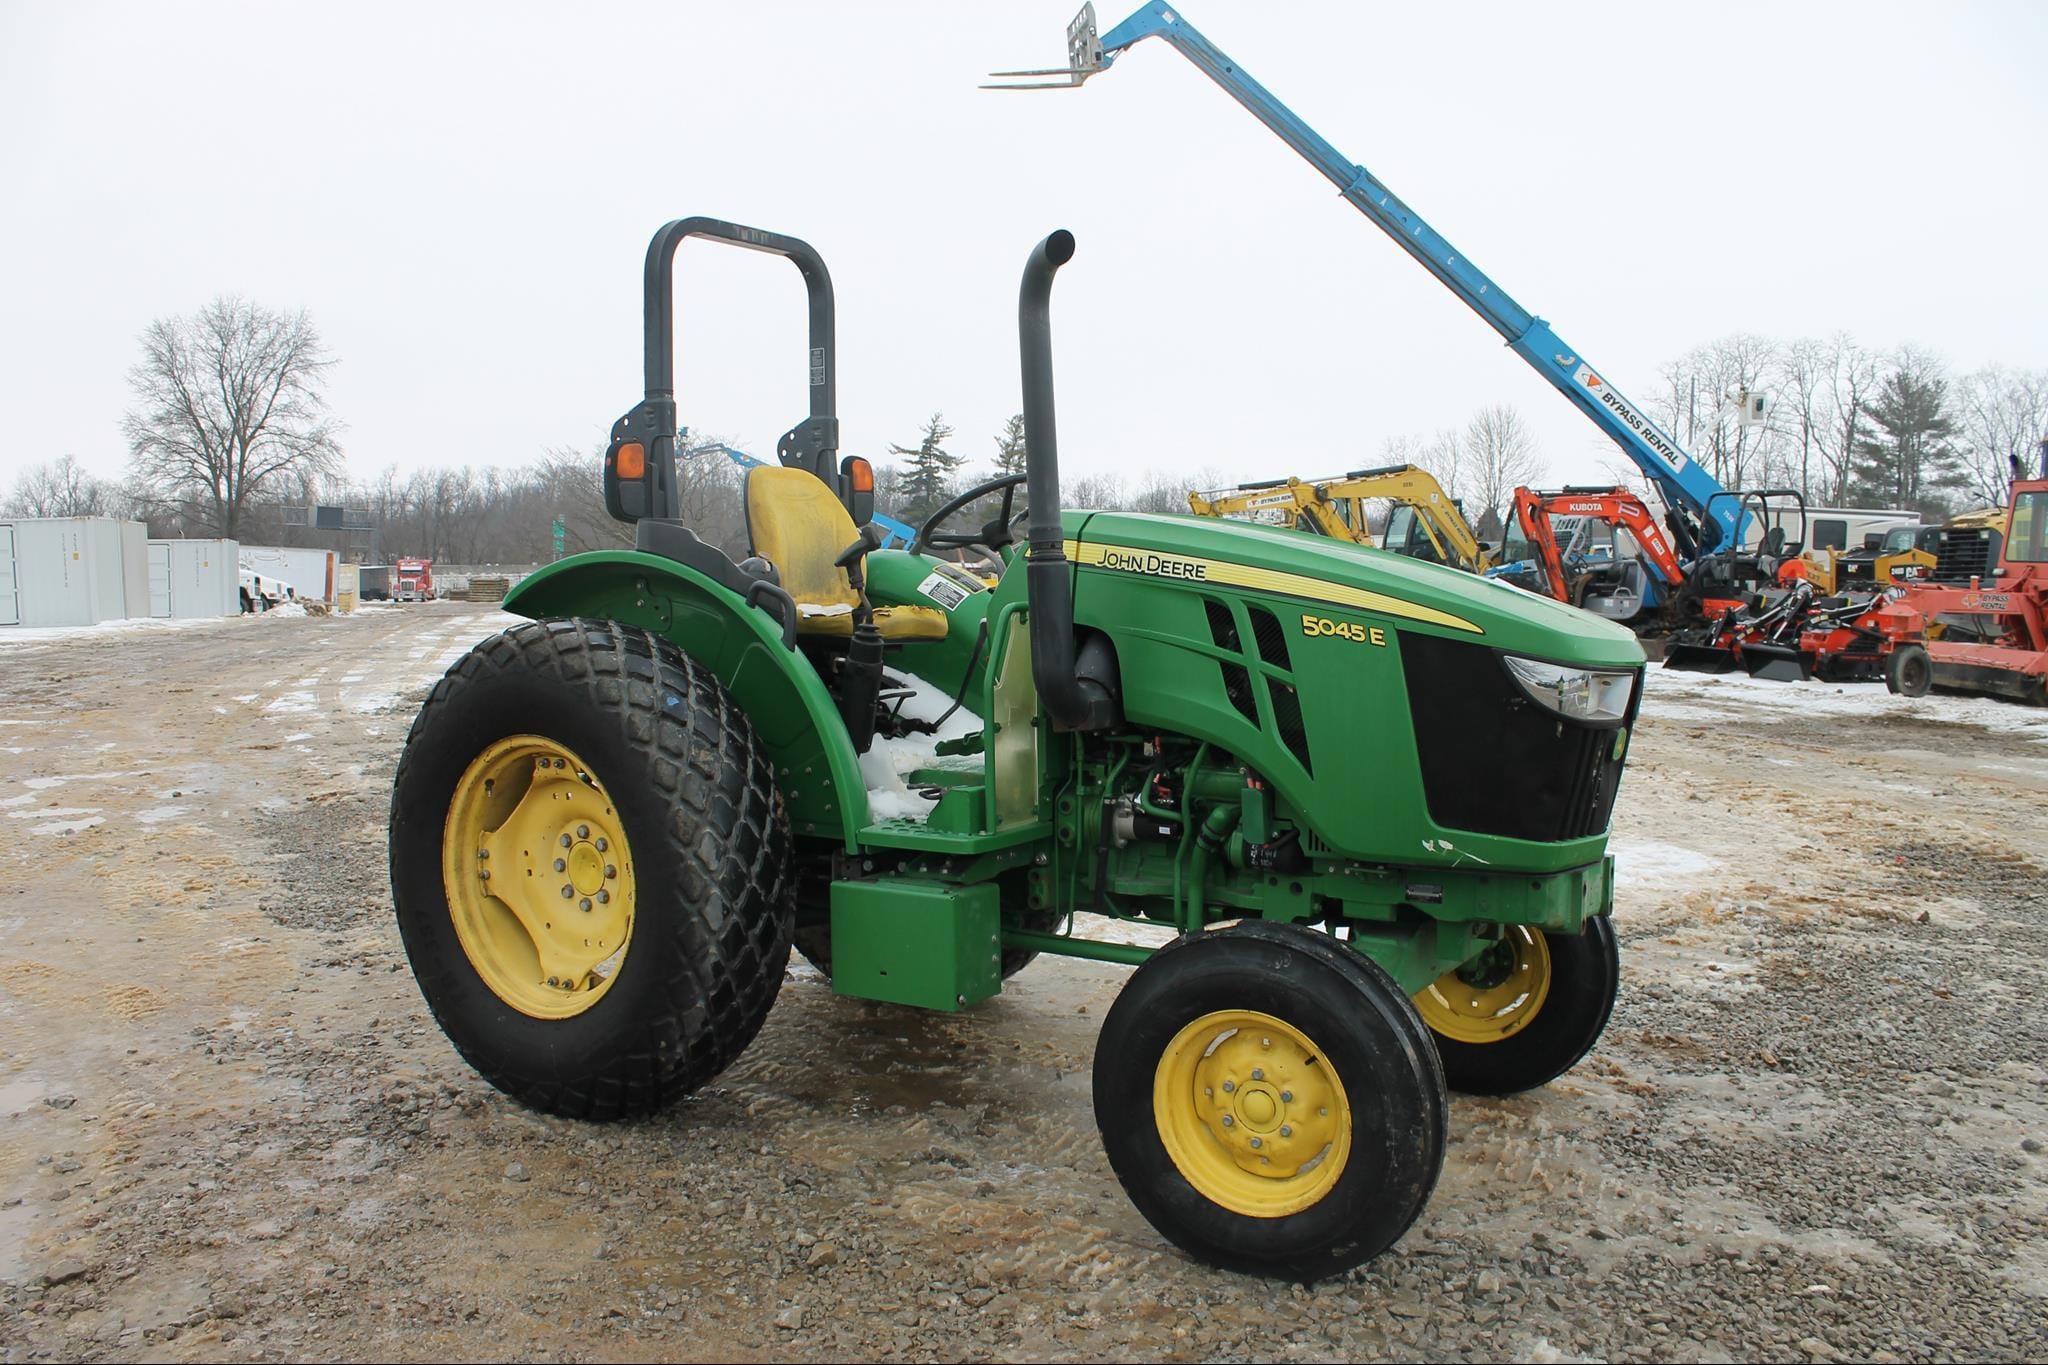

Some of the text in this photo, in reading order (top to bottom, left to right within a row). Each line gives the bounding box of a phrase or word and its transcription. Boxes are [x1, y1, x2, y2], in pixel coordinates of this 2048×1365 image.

[1602, 392, 1680, 466] BYPASS RENTAL
[1569, 503, 1603, 511] KUBOTA
[1097, 549, 1207, 579] JOHN DEERE
[1981, 602, 2006, 610] RENTAL
[1983, 594, 2009, 602] BYPASS
[1301, 614, 1386, 647] 5045 E
